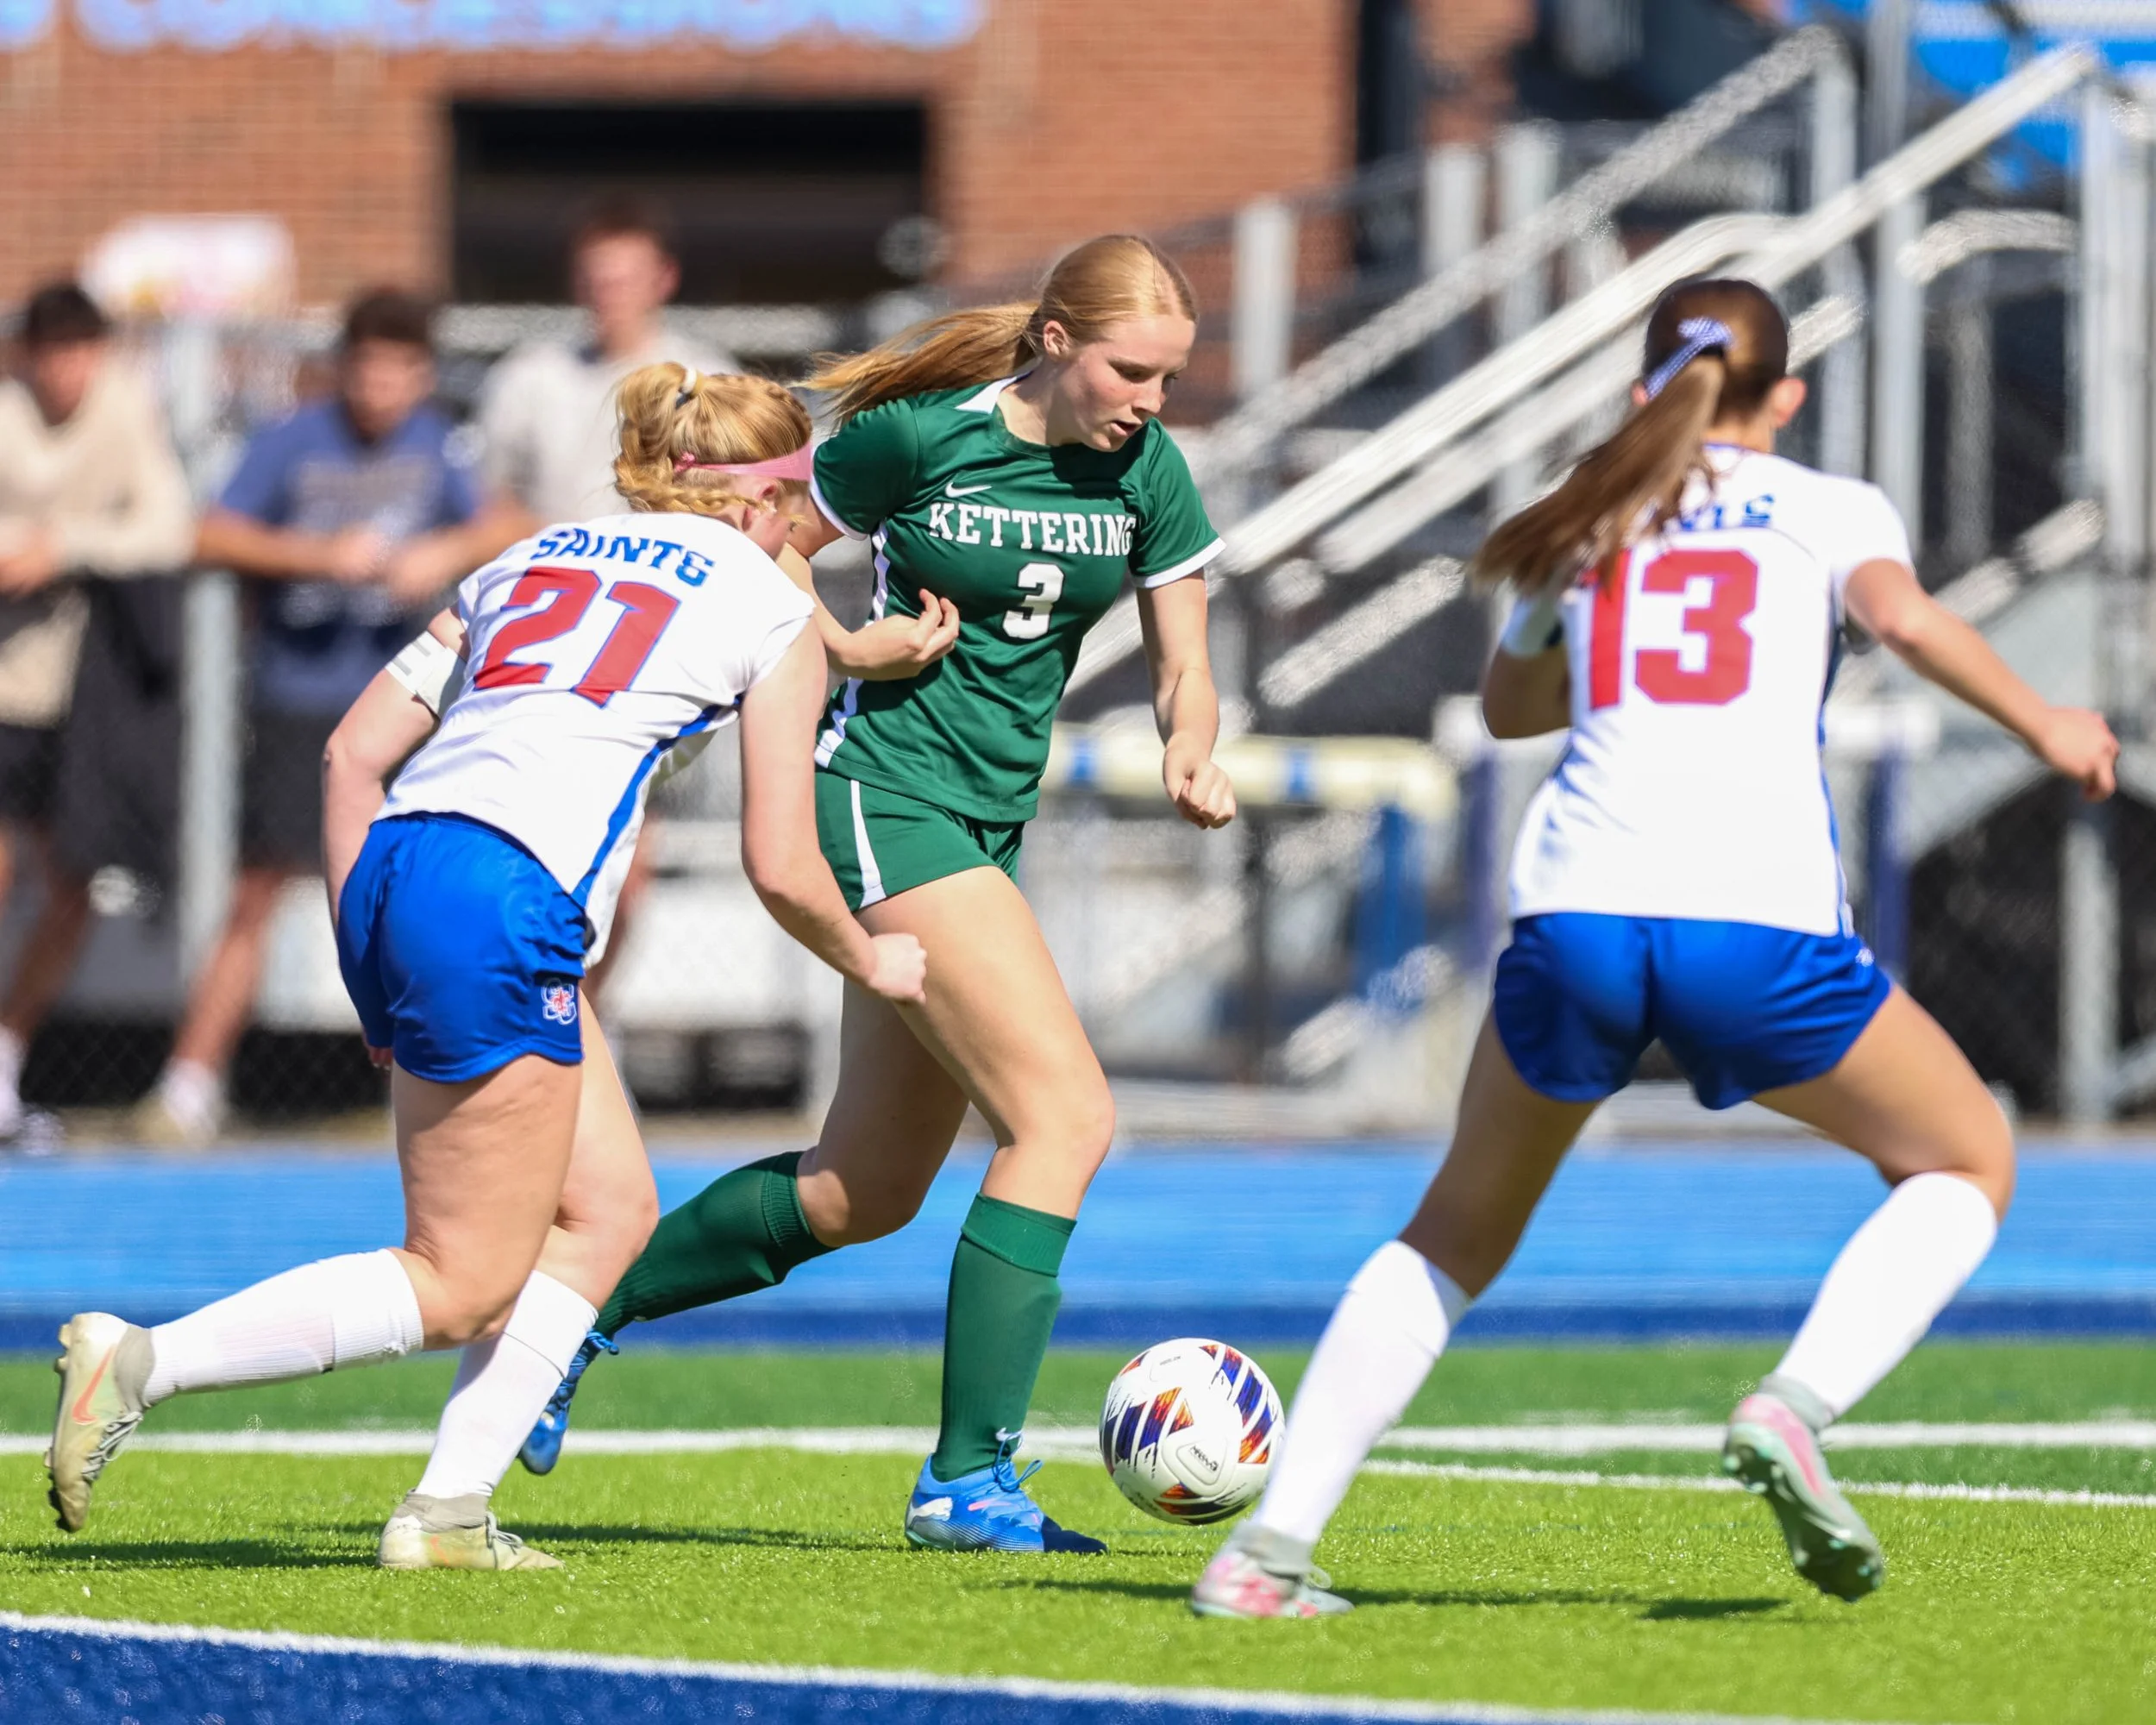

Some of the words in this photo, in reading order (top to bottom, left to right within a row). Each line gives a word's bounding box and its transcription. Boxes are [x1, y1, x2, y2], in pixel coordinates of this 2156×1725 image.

[530, 527, 715, 586] SAINTS
[929, 501, 1137, 556] KETTERING
[473, 565, 682, 709] 21
[1003, 562, 1064, 639] 3
[1583, 547, 1759, 711] 13
